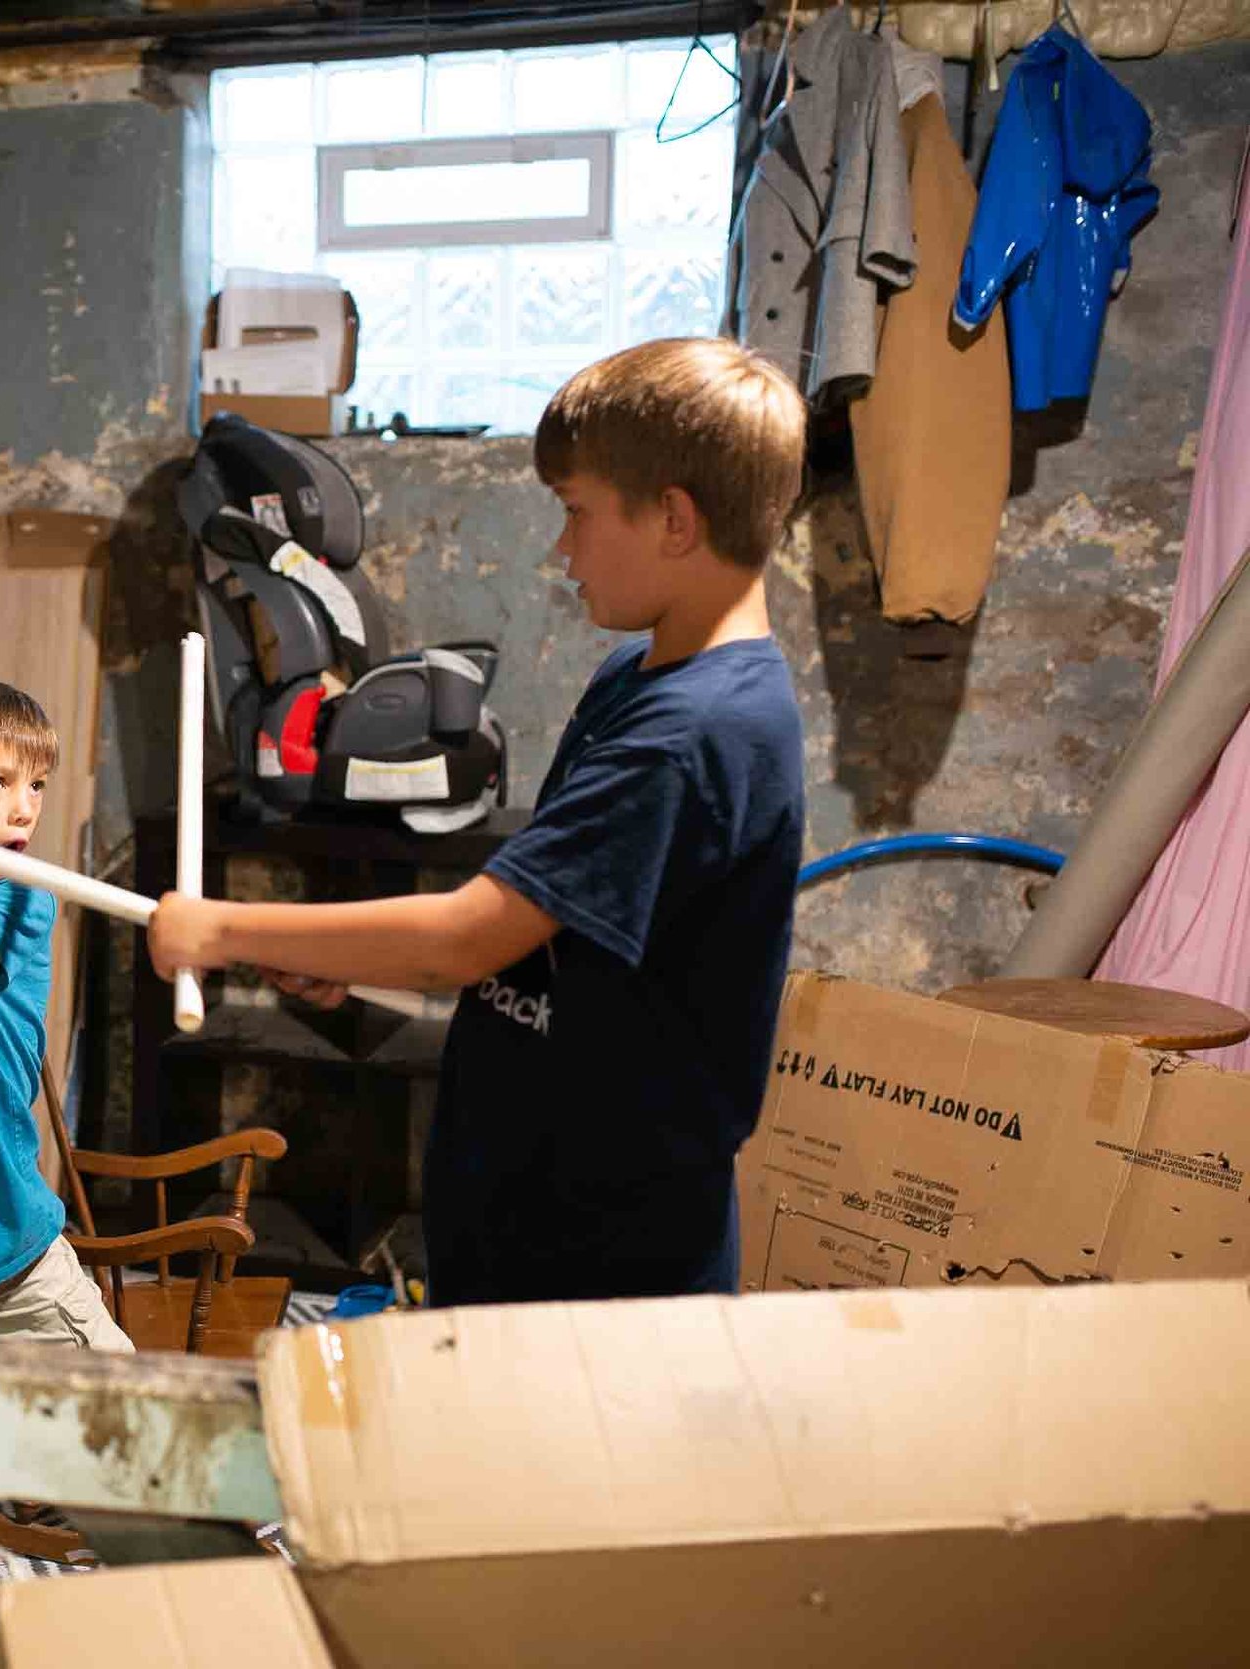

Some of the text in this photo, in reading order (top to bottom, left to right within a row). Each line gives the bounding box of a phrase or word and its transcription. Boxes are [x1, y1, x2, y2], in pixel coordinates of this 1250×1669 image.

[840, 1070, 1003, 1130] DO NOT LAY FLAT
